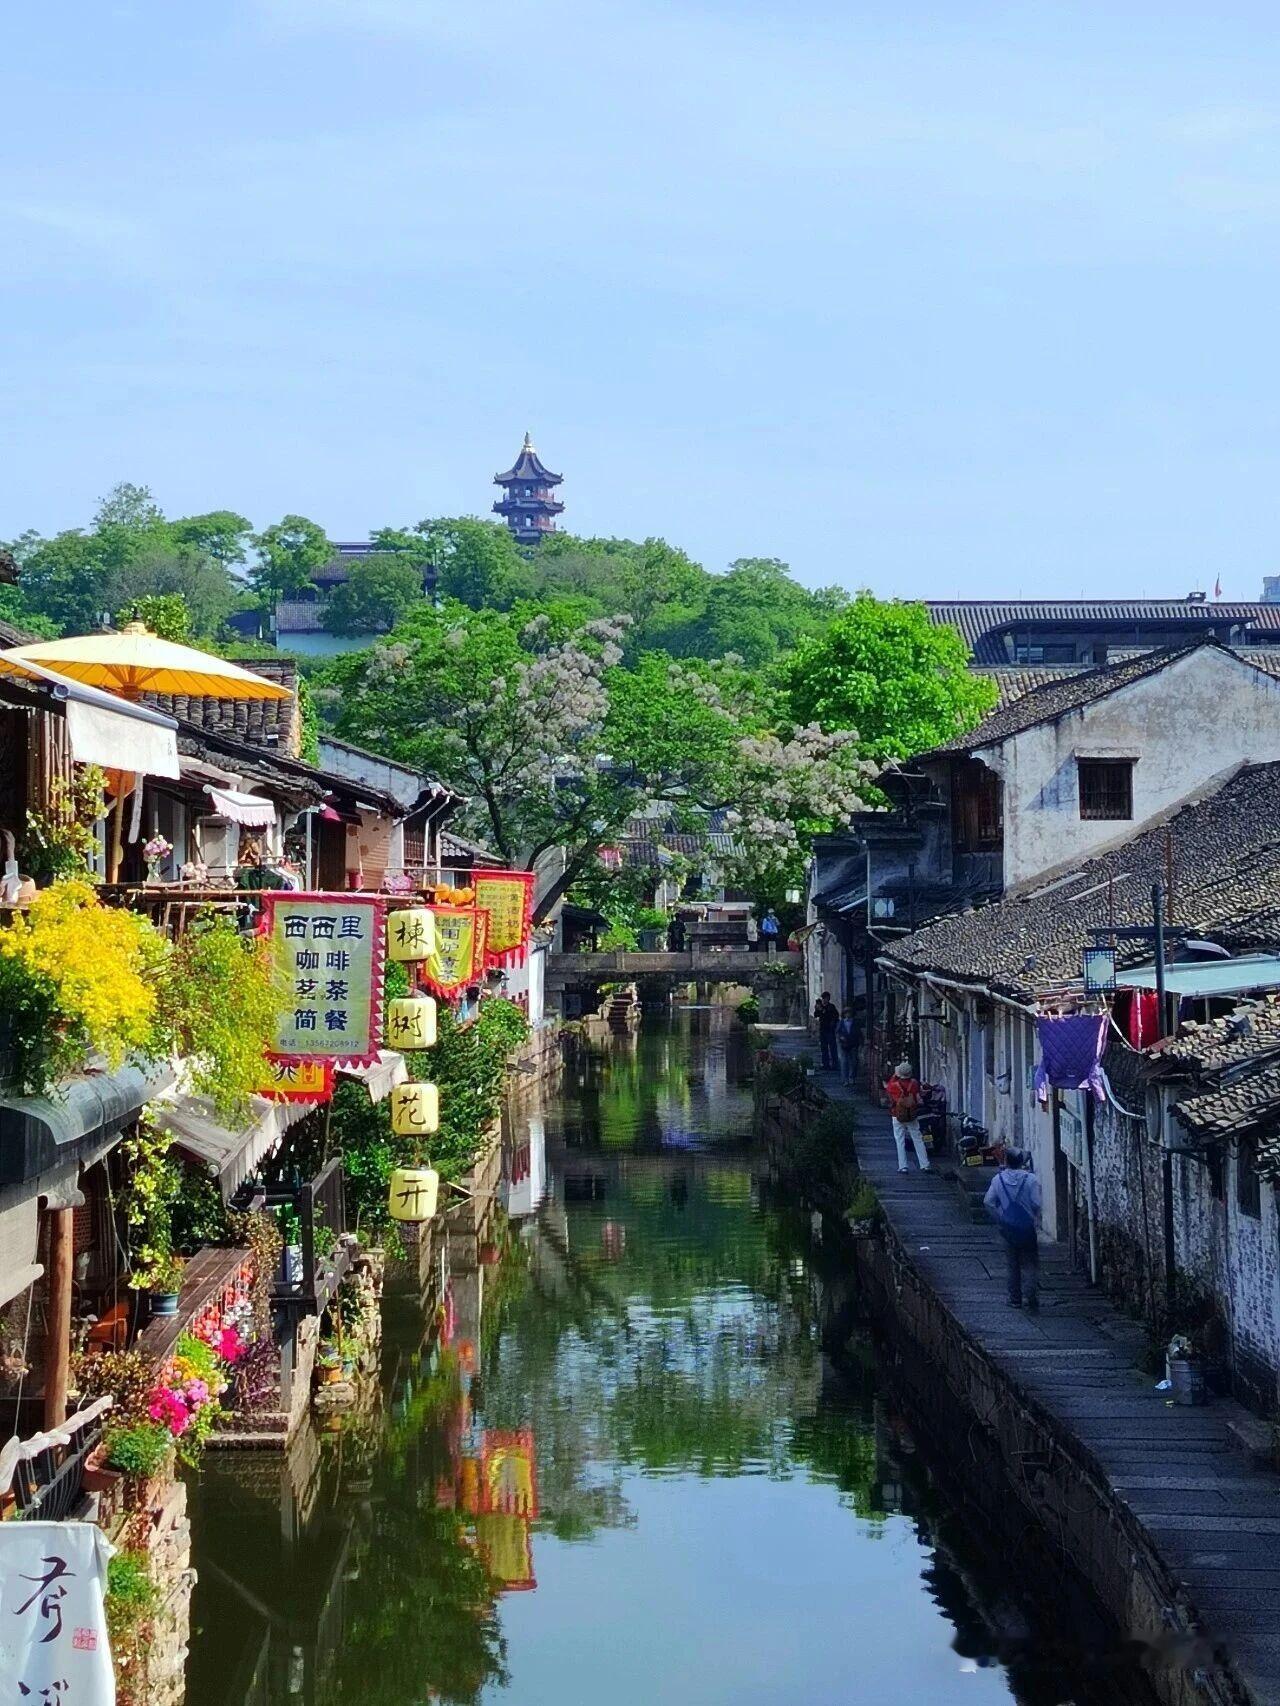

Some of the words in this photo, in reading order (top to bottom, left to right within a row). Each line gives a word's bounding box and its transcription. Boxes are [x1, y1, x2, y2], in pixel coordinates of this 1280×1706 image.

[284, 915, 364, 940] 西西里
[296, 950, 350, 971] 咖啡
[295, 978, 349, 1001] 茗茶
[294, 1008, 348, 1032] 简餐
